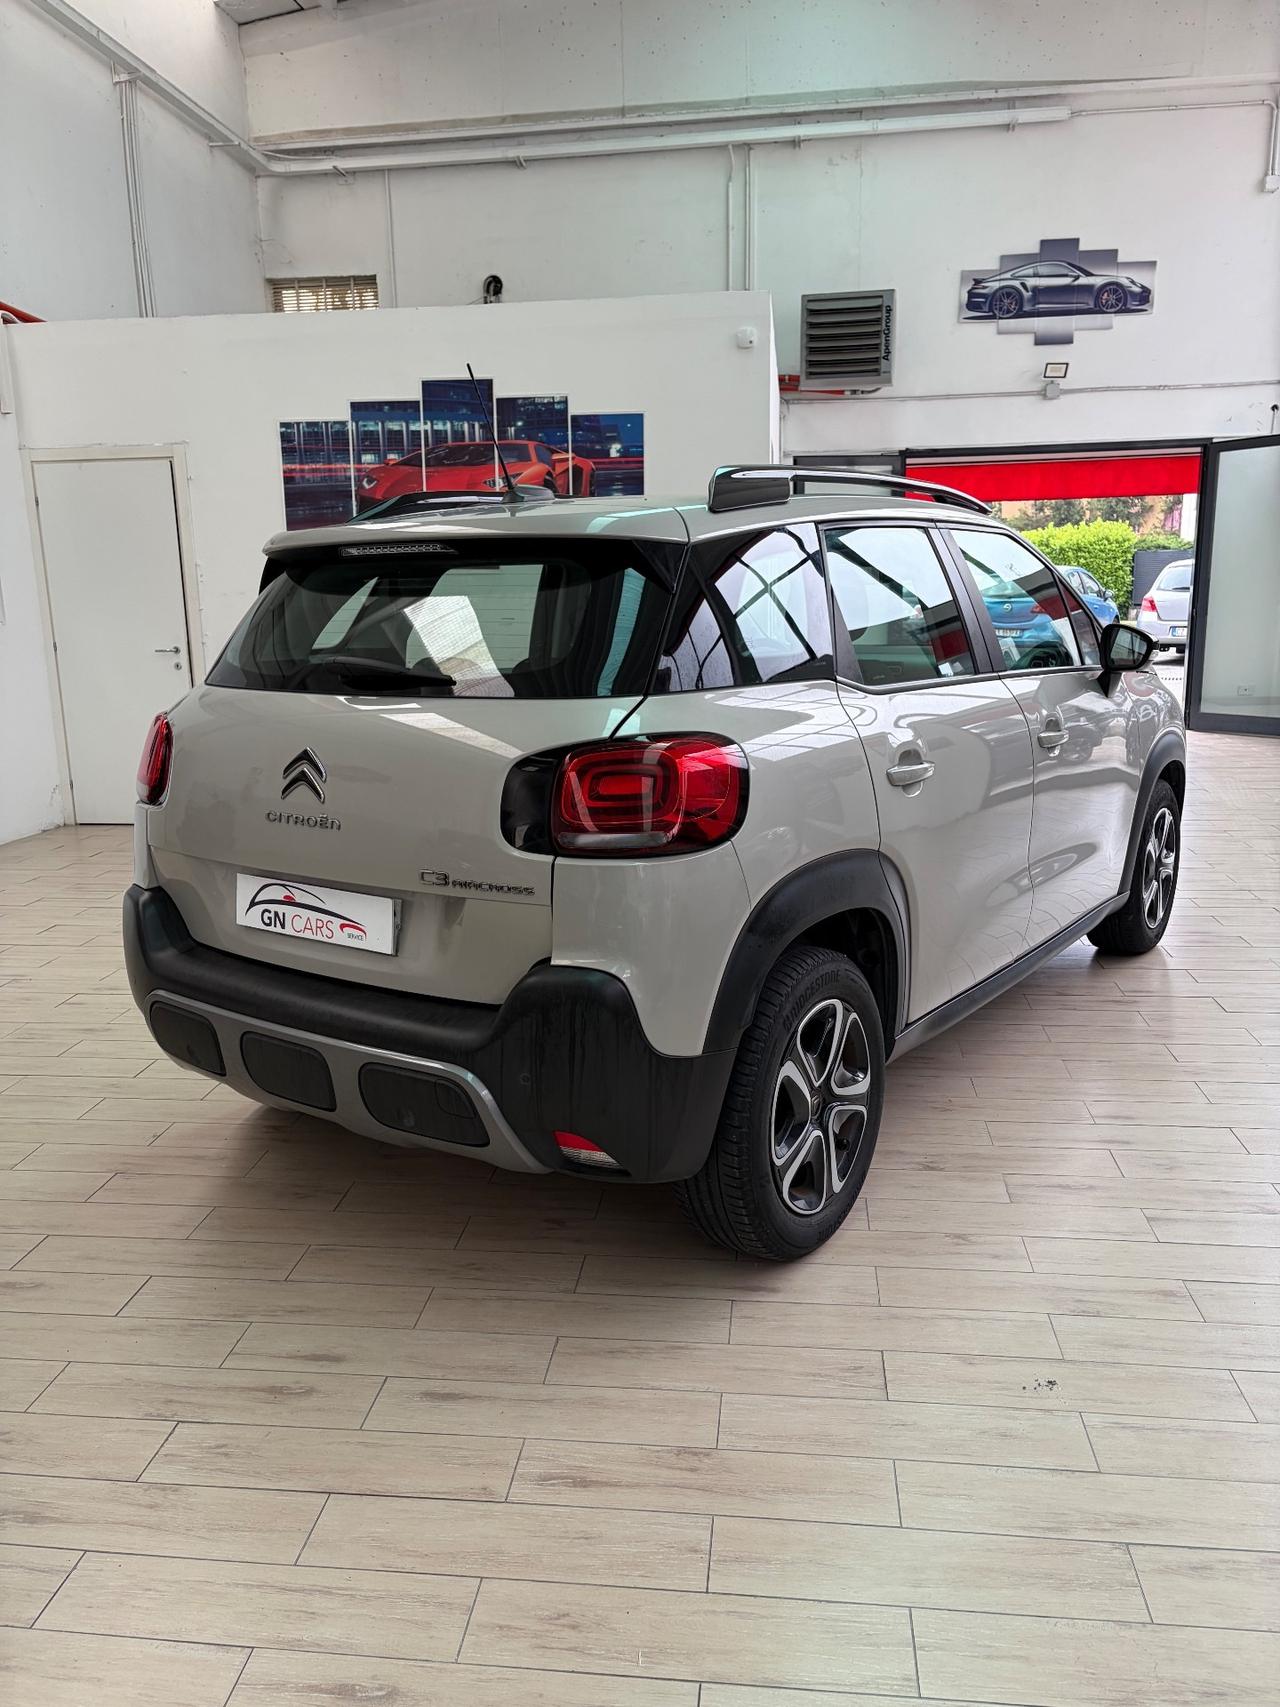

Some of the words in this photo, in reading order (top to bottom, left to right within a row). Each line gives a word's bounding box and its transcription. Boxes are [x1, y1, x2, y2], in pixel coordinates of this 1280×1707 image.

[882, 304, 893, 361] ApenGroup
[420, 869, 449, 887] C3
[260, 908, 286, 930] GN
[291, 914, 334, 940] CARS
[347, 932, 364, 942] SERVICE
